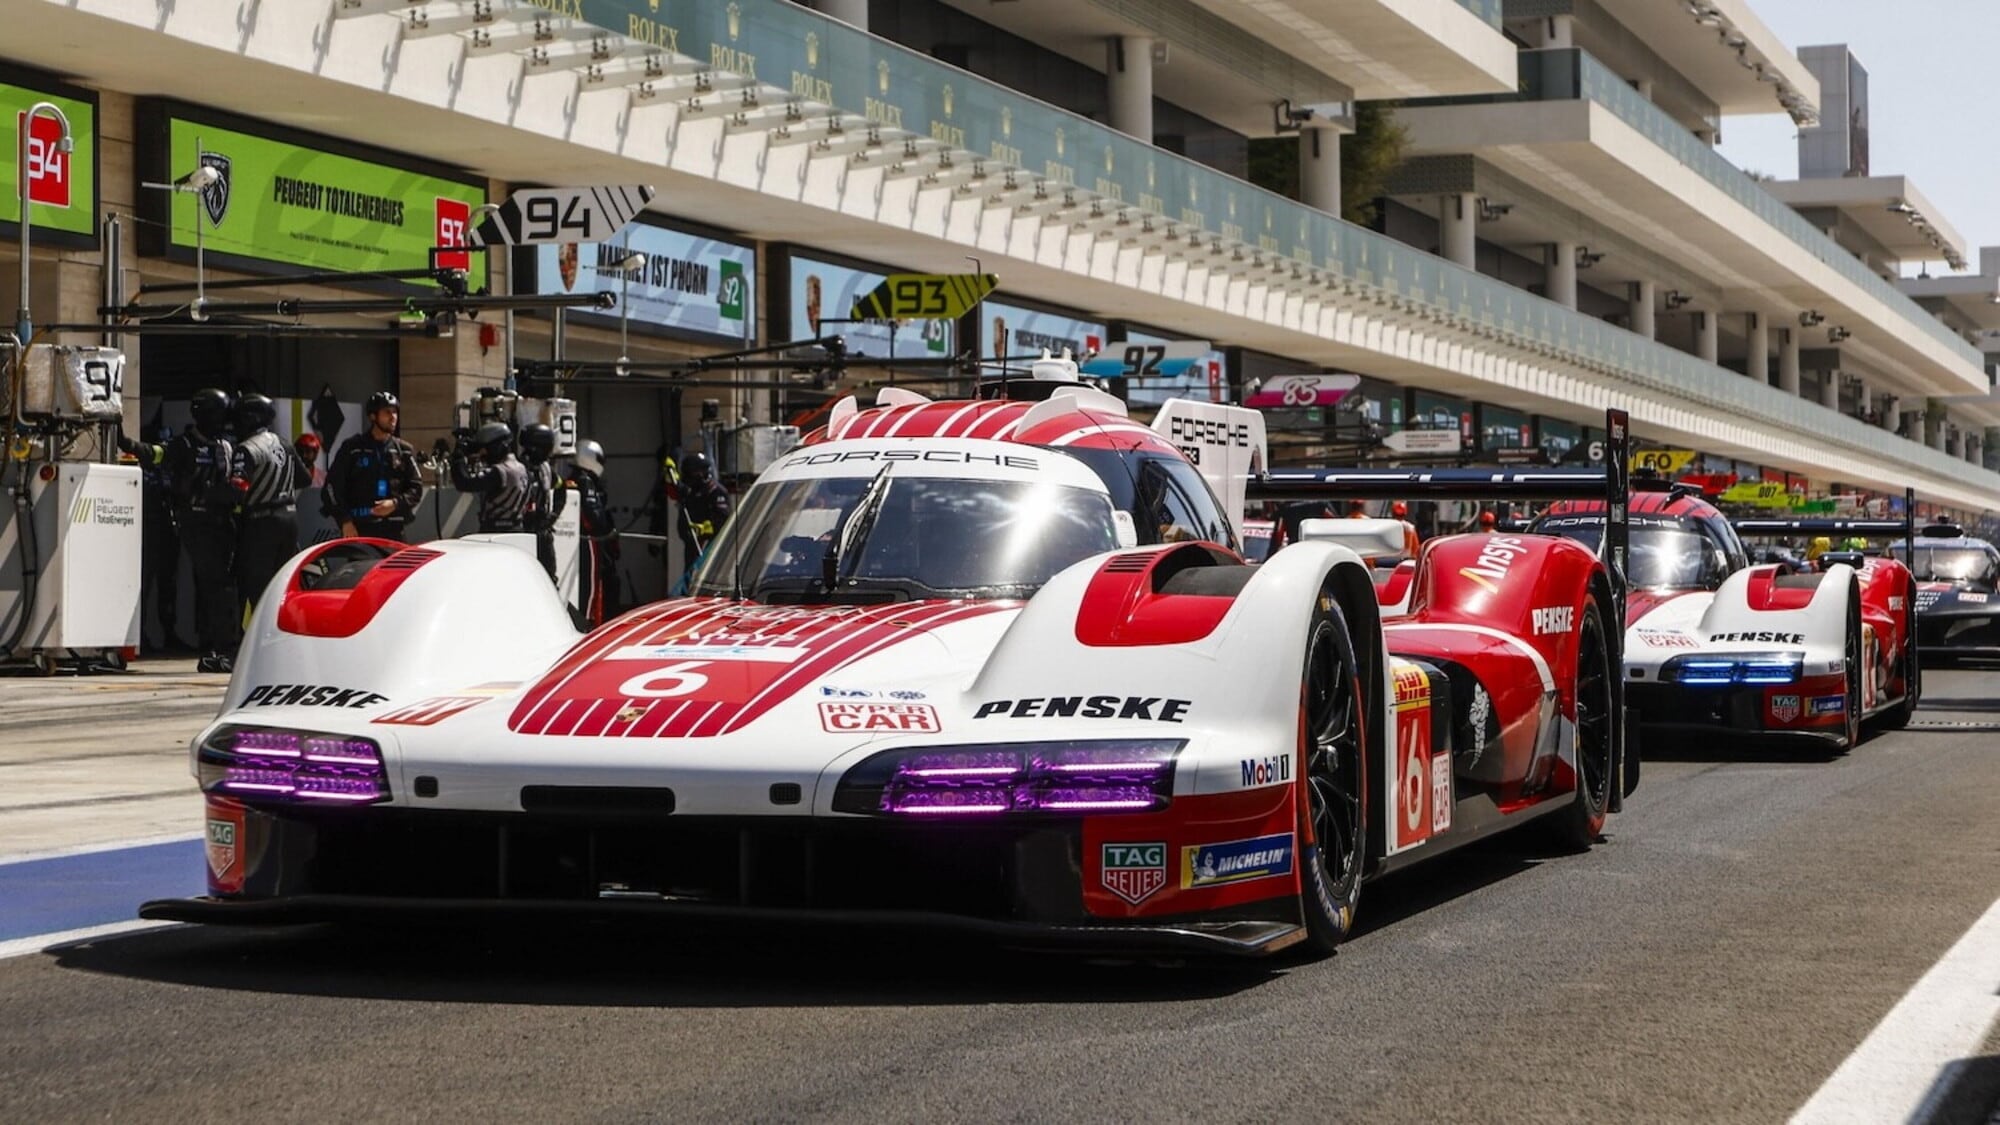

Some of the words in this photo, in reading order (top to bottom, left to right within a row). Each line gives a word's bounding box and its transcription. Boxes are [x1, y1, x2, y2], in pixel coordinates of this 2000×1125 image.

[528, 0, 584, 21] LEX
[628, 13, 680, 54] ROLEX
[710, 42, 757, 80] ROLEX
[791, 71, 833, 105] ROLEX
[865, 97, 903, 128] ROLEX
[274, 175, 324, 211] PEUGEOT
[325, 185, 405, 228] TOTALENERGIES
[526, 196, 592, 239] 94
[651, 254, 670, 288] 1ST
[895, 280, 947, 314] 93
[1123, 346, 1166, 376] 92
[1283, 376, 1322, 406] 85
[1171, 416, 1248, 447] PORSCHE
[782, 449, 1040, 470] PORSCHE
[1177, 445, 1200, 466] 63
[1587, 441, 1607, 461] 6
[1644, 453, 1672, 470] 60
[97, 505, 134, 515] PEUGEOT
[1459, 536, 1528, 595] Ansys
[1532, 606, 1574, 636] PENSKE
[1710, 631, 1807, 645] PENSKE
[618, 661, 716, 698] 6
[236, 684, 392, 710] PENSKE
[827, 704, 926, 714] HYPER
[973, 695, 1192, 723] PENSKE
[1775, 696, 1797, 707] TAG
[830, 713, 931, 730] CAR
[1241, 757, 1279, 787] Mobil
[1280, 754, 1289, 780] 1
[1406, 718, 1424, 832] 6
[209, 824, 233, 843] TAG
[1107, 848, 1162, 866] TAG
[1217, 848, 1285, 873] MICHELIN
[1106, 870, 1162, 899] HEUER
